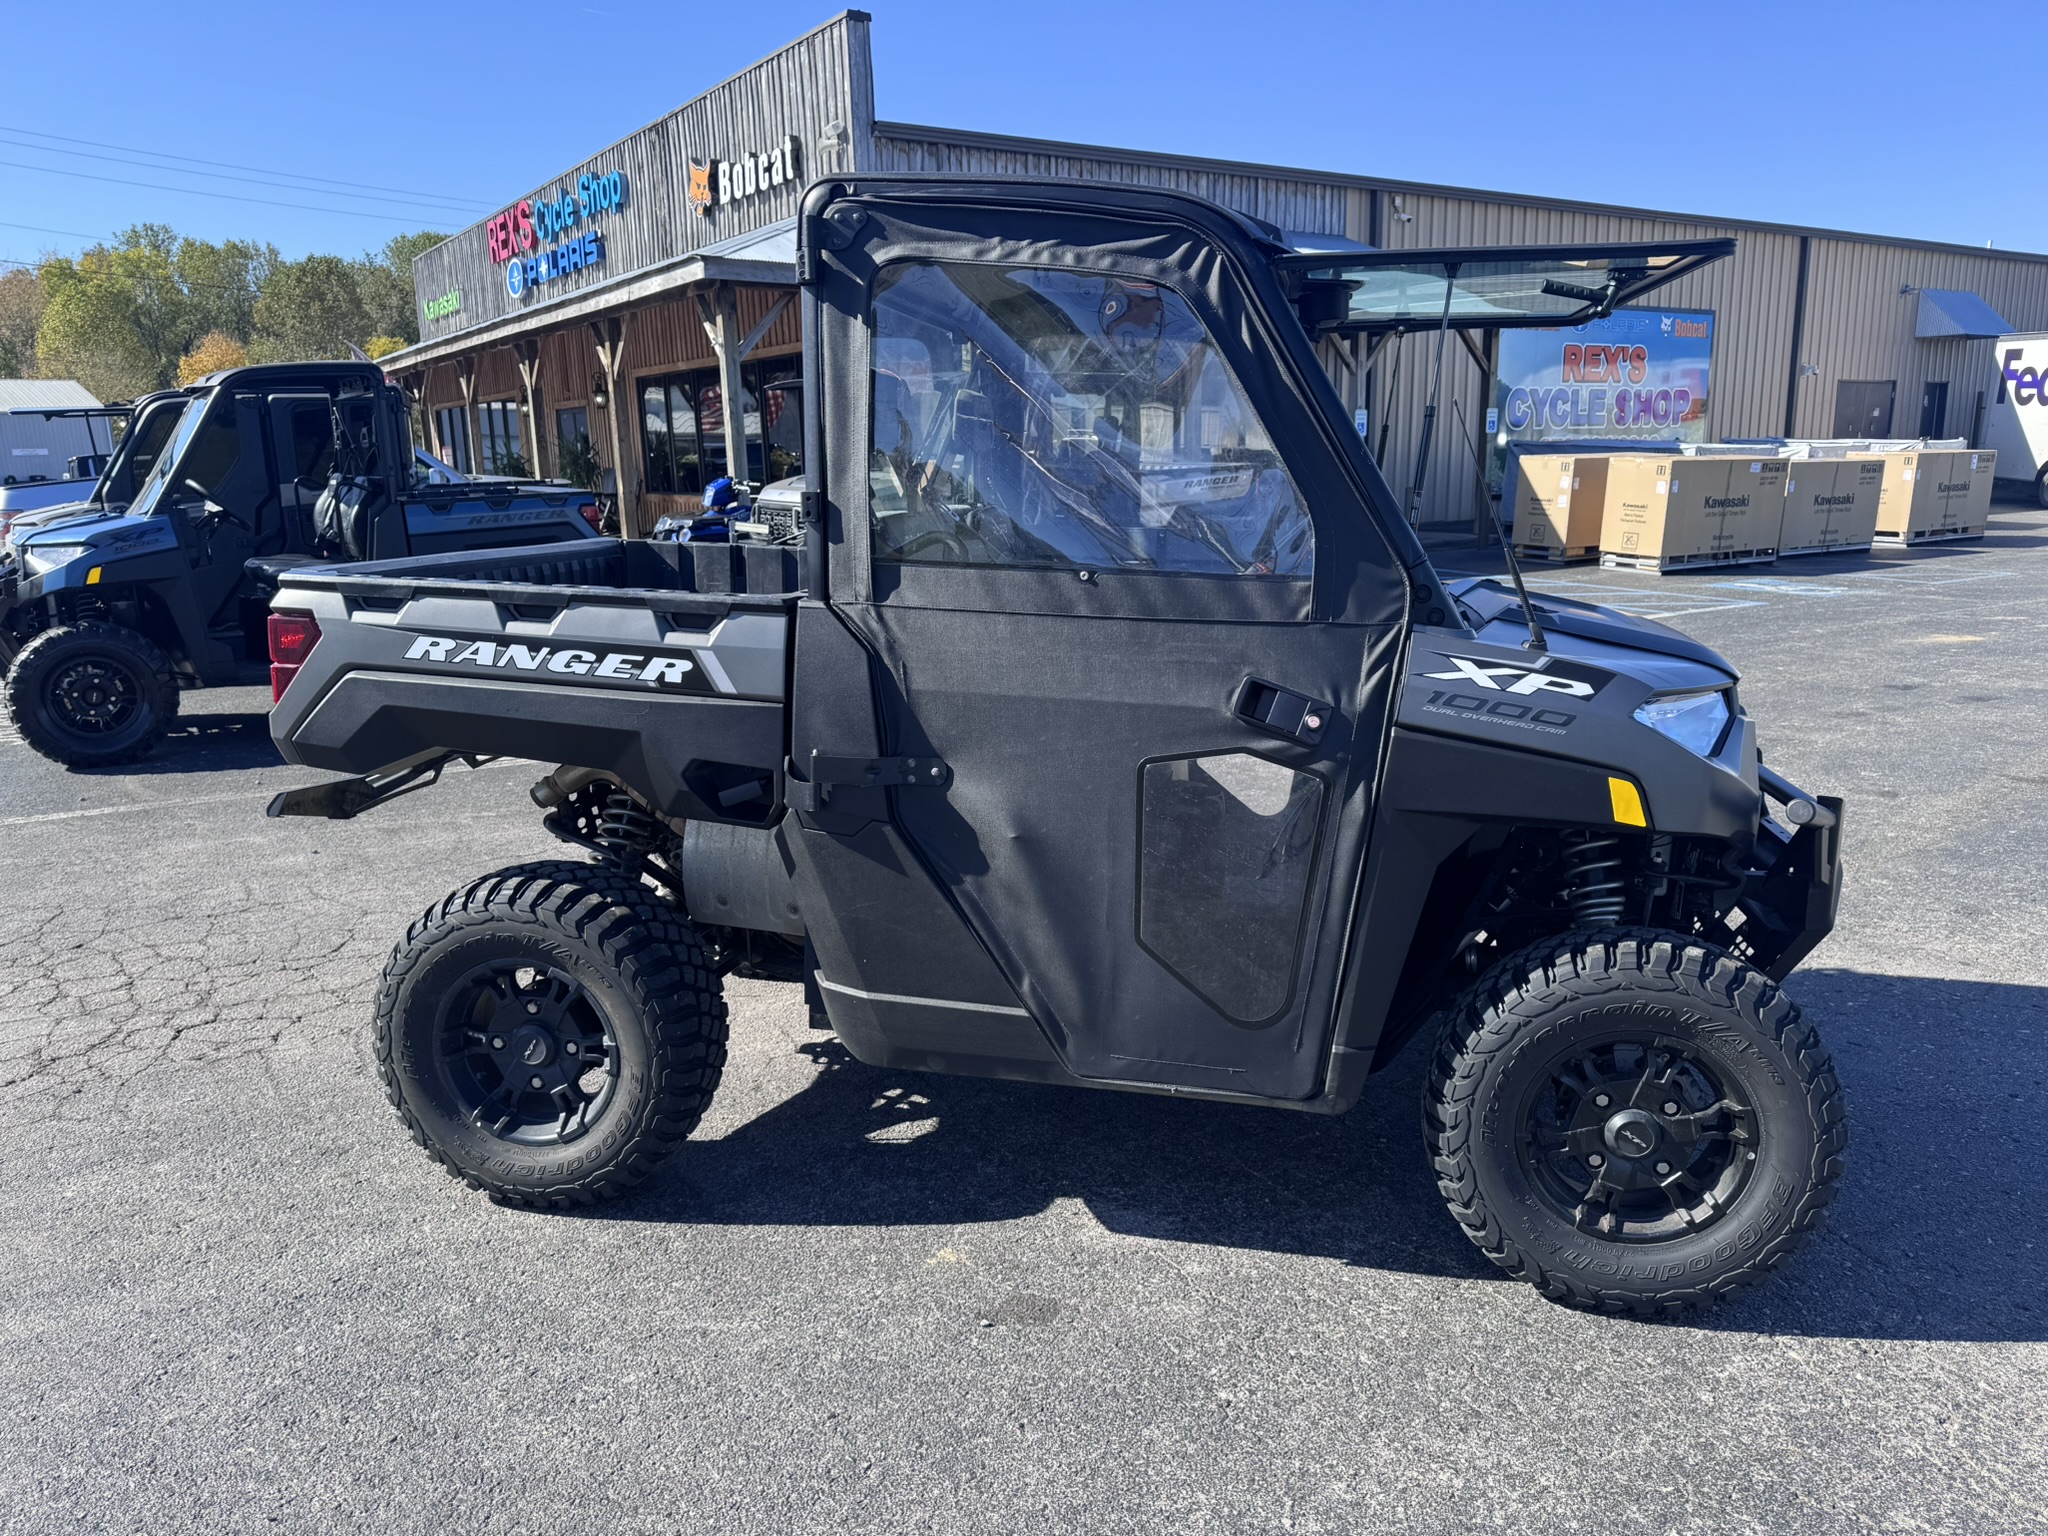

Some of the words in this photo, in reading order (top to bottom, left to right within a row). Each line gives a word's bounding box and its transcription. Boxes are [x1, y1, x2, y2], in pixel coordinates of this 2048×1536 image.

[718, 135, 794, 205] Bobcat
[487, 200, 534, 265] REX'S
[534, 188, 576, 244] Cycle
[578, 170, 624, 218] Shop
[527, 231, 599, 287] POLARIS
[423, 284, 460, 321] Kawasaki
[1674, 318, 1709, 338] Bobcat
[1562, 343, 1648, 385] REX'S
[1506, 386, 1608, 430] CYCLE
[1613, 386, 1692, 429] SHOP
[1184, 475, 1239, 489] RANGER
[1813, 493, 1855, 506] Kawasaki
[1937, 481, 1971, 493] Kawasaki
[468, 509, 568, 526] RANGER
[1703, 494, 1750, 509] Kawasaki
[402, 635, 694, 684] RANGER
[1421, 656, 1596, 697] XP
[1422, 705, 1459, 716] DUAL
[1462, 712, 1534, 729] OVERHEAD
[1536, 726, 1568, 736] CAM
[1425, 690, 1577, 727] 1000
[492, 1063, 644, 1179] BFGoodrich
[1620, 1130, 1647, 1148] XP
[1564, 1174, 1794, 1282] BFGoodrich
